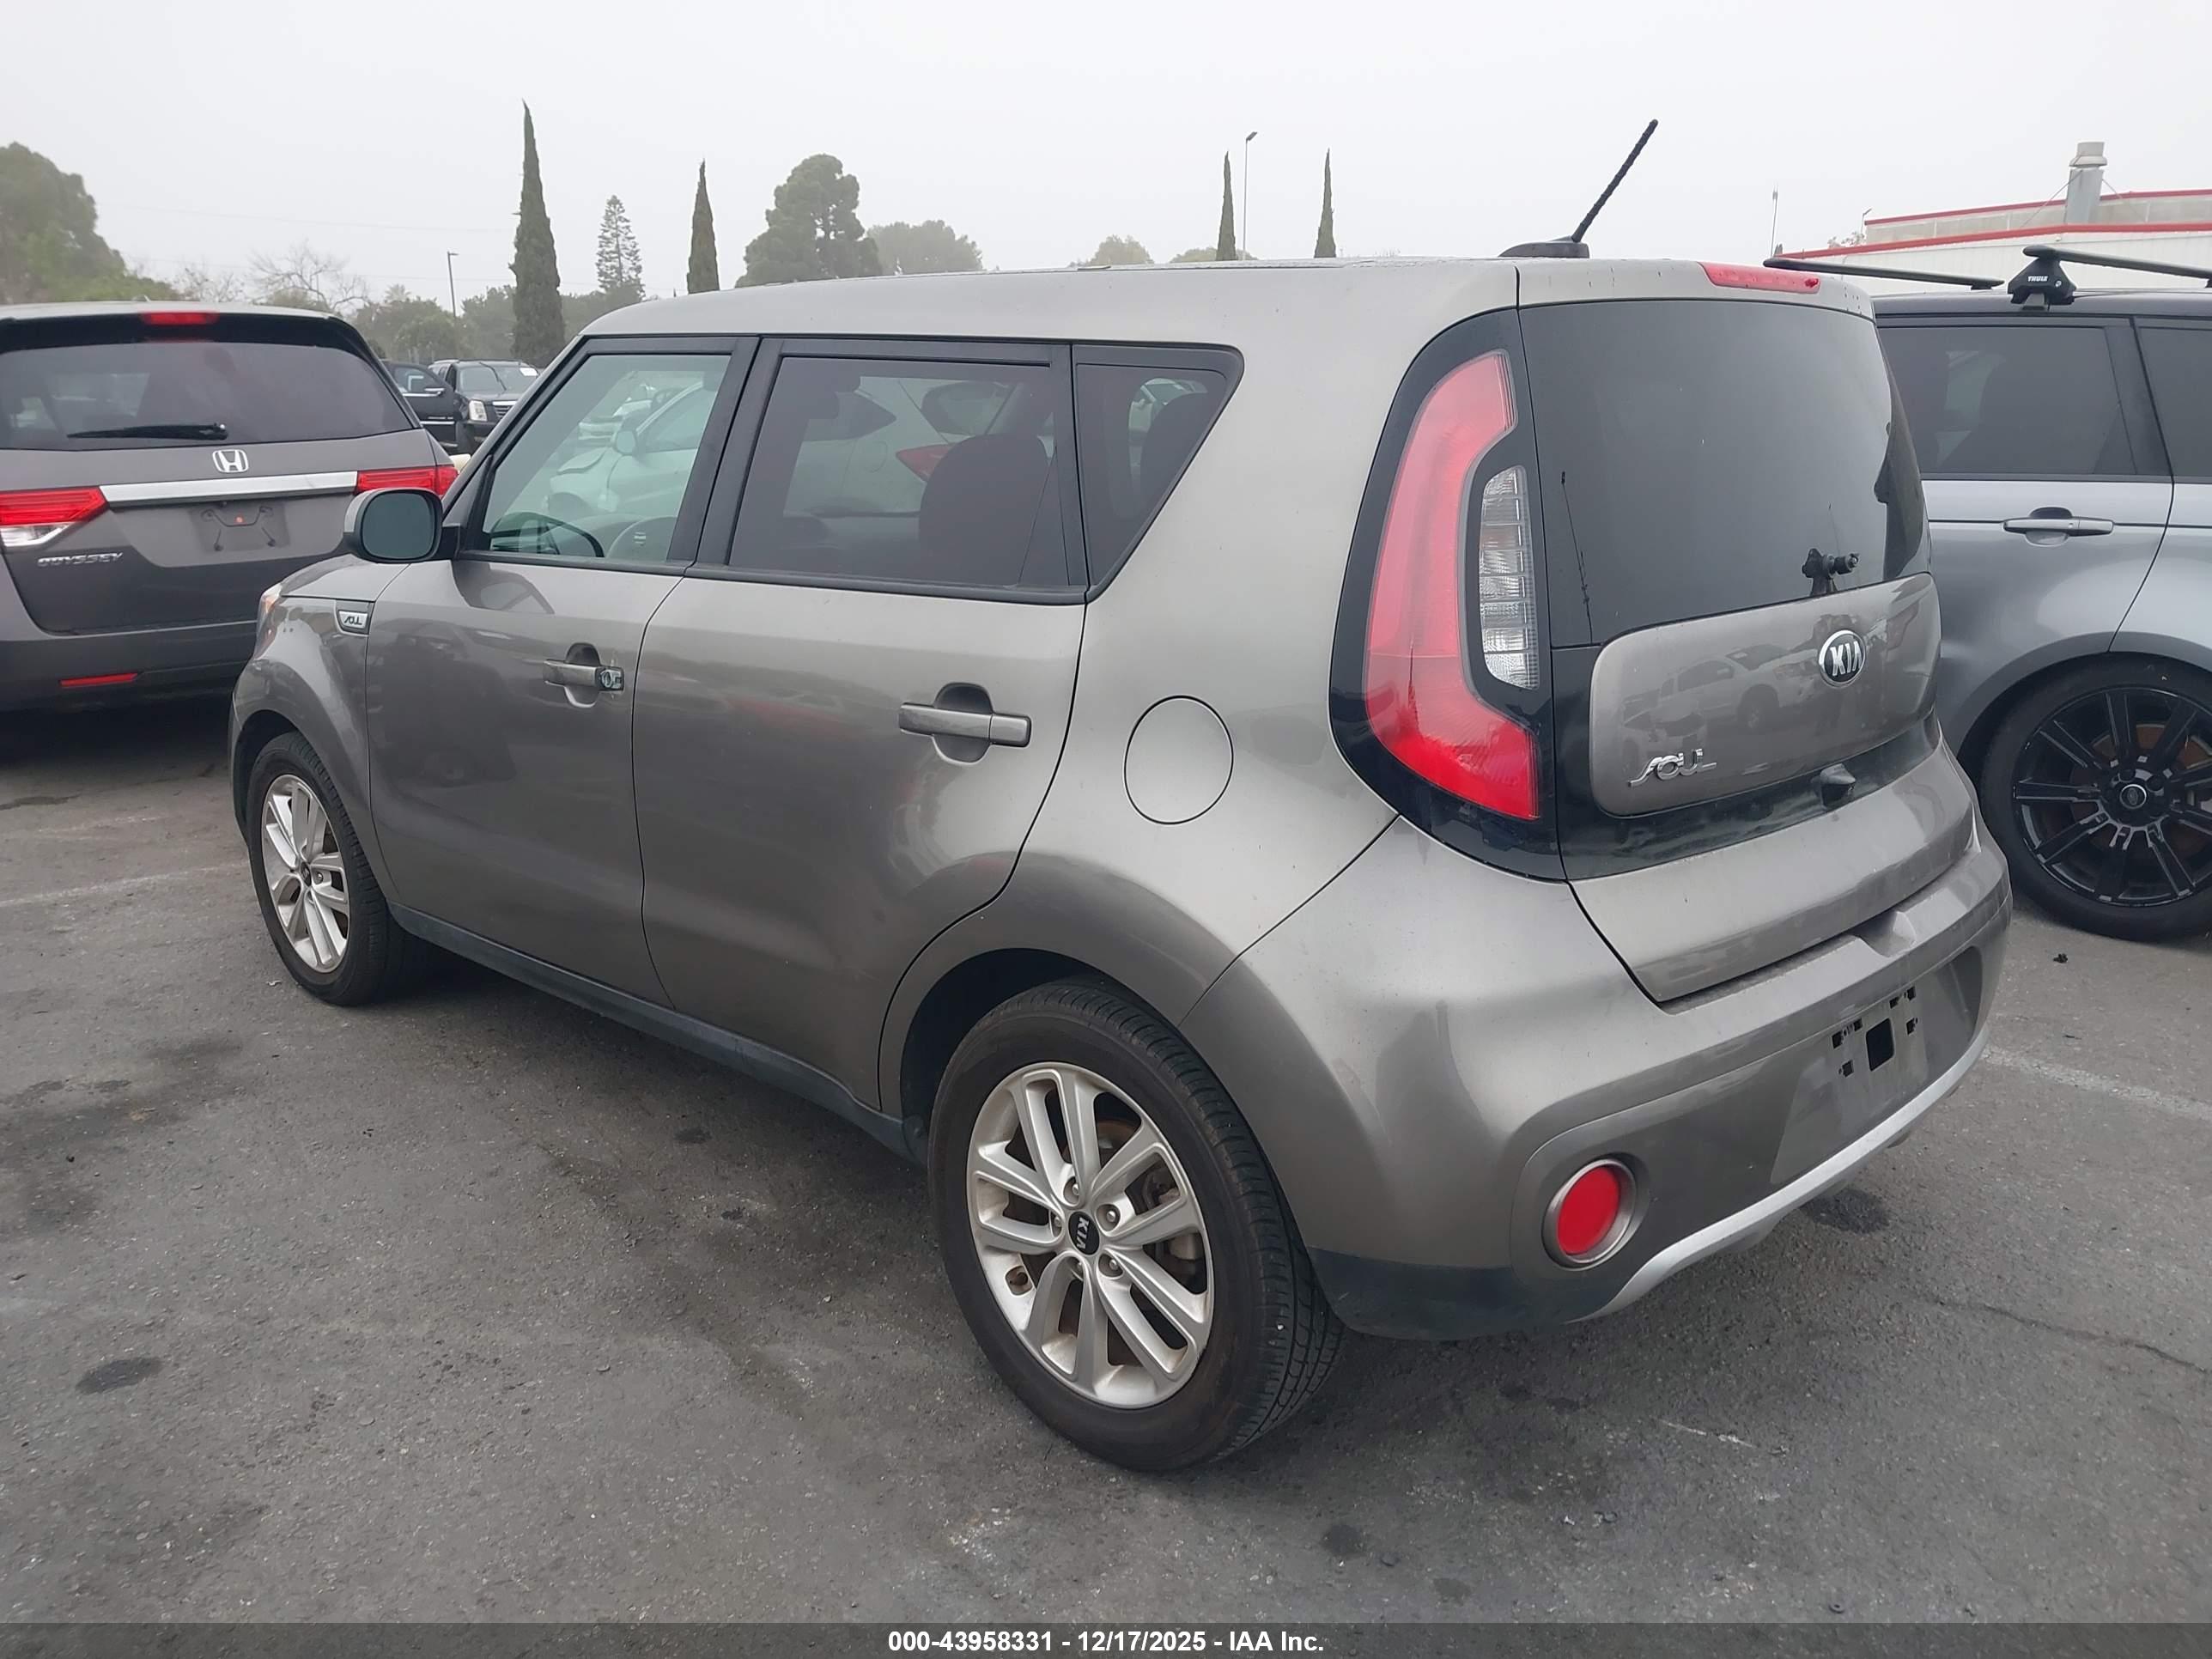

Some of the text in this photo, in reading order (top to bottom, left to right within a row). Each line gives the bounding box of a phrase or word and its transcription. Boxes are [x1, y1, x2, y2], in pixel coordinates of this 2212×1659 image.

[37, 552, 124, 567] ODYSSEY
[1829, 641, 1863, 677] KIA
[1627, 748, 1717, 787] SOUL
[1076, 1217, 1090, 1249] KIA
